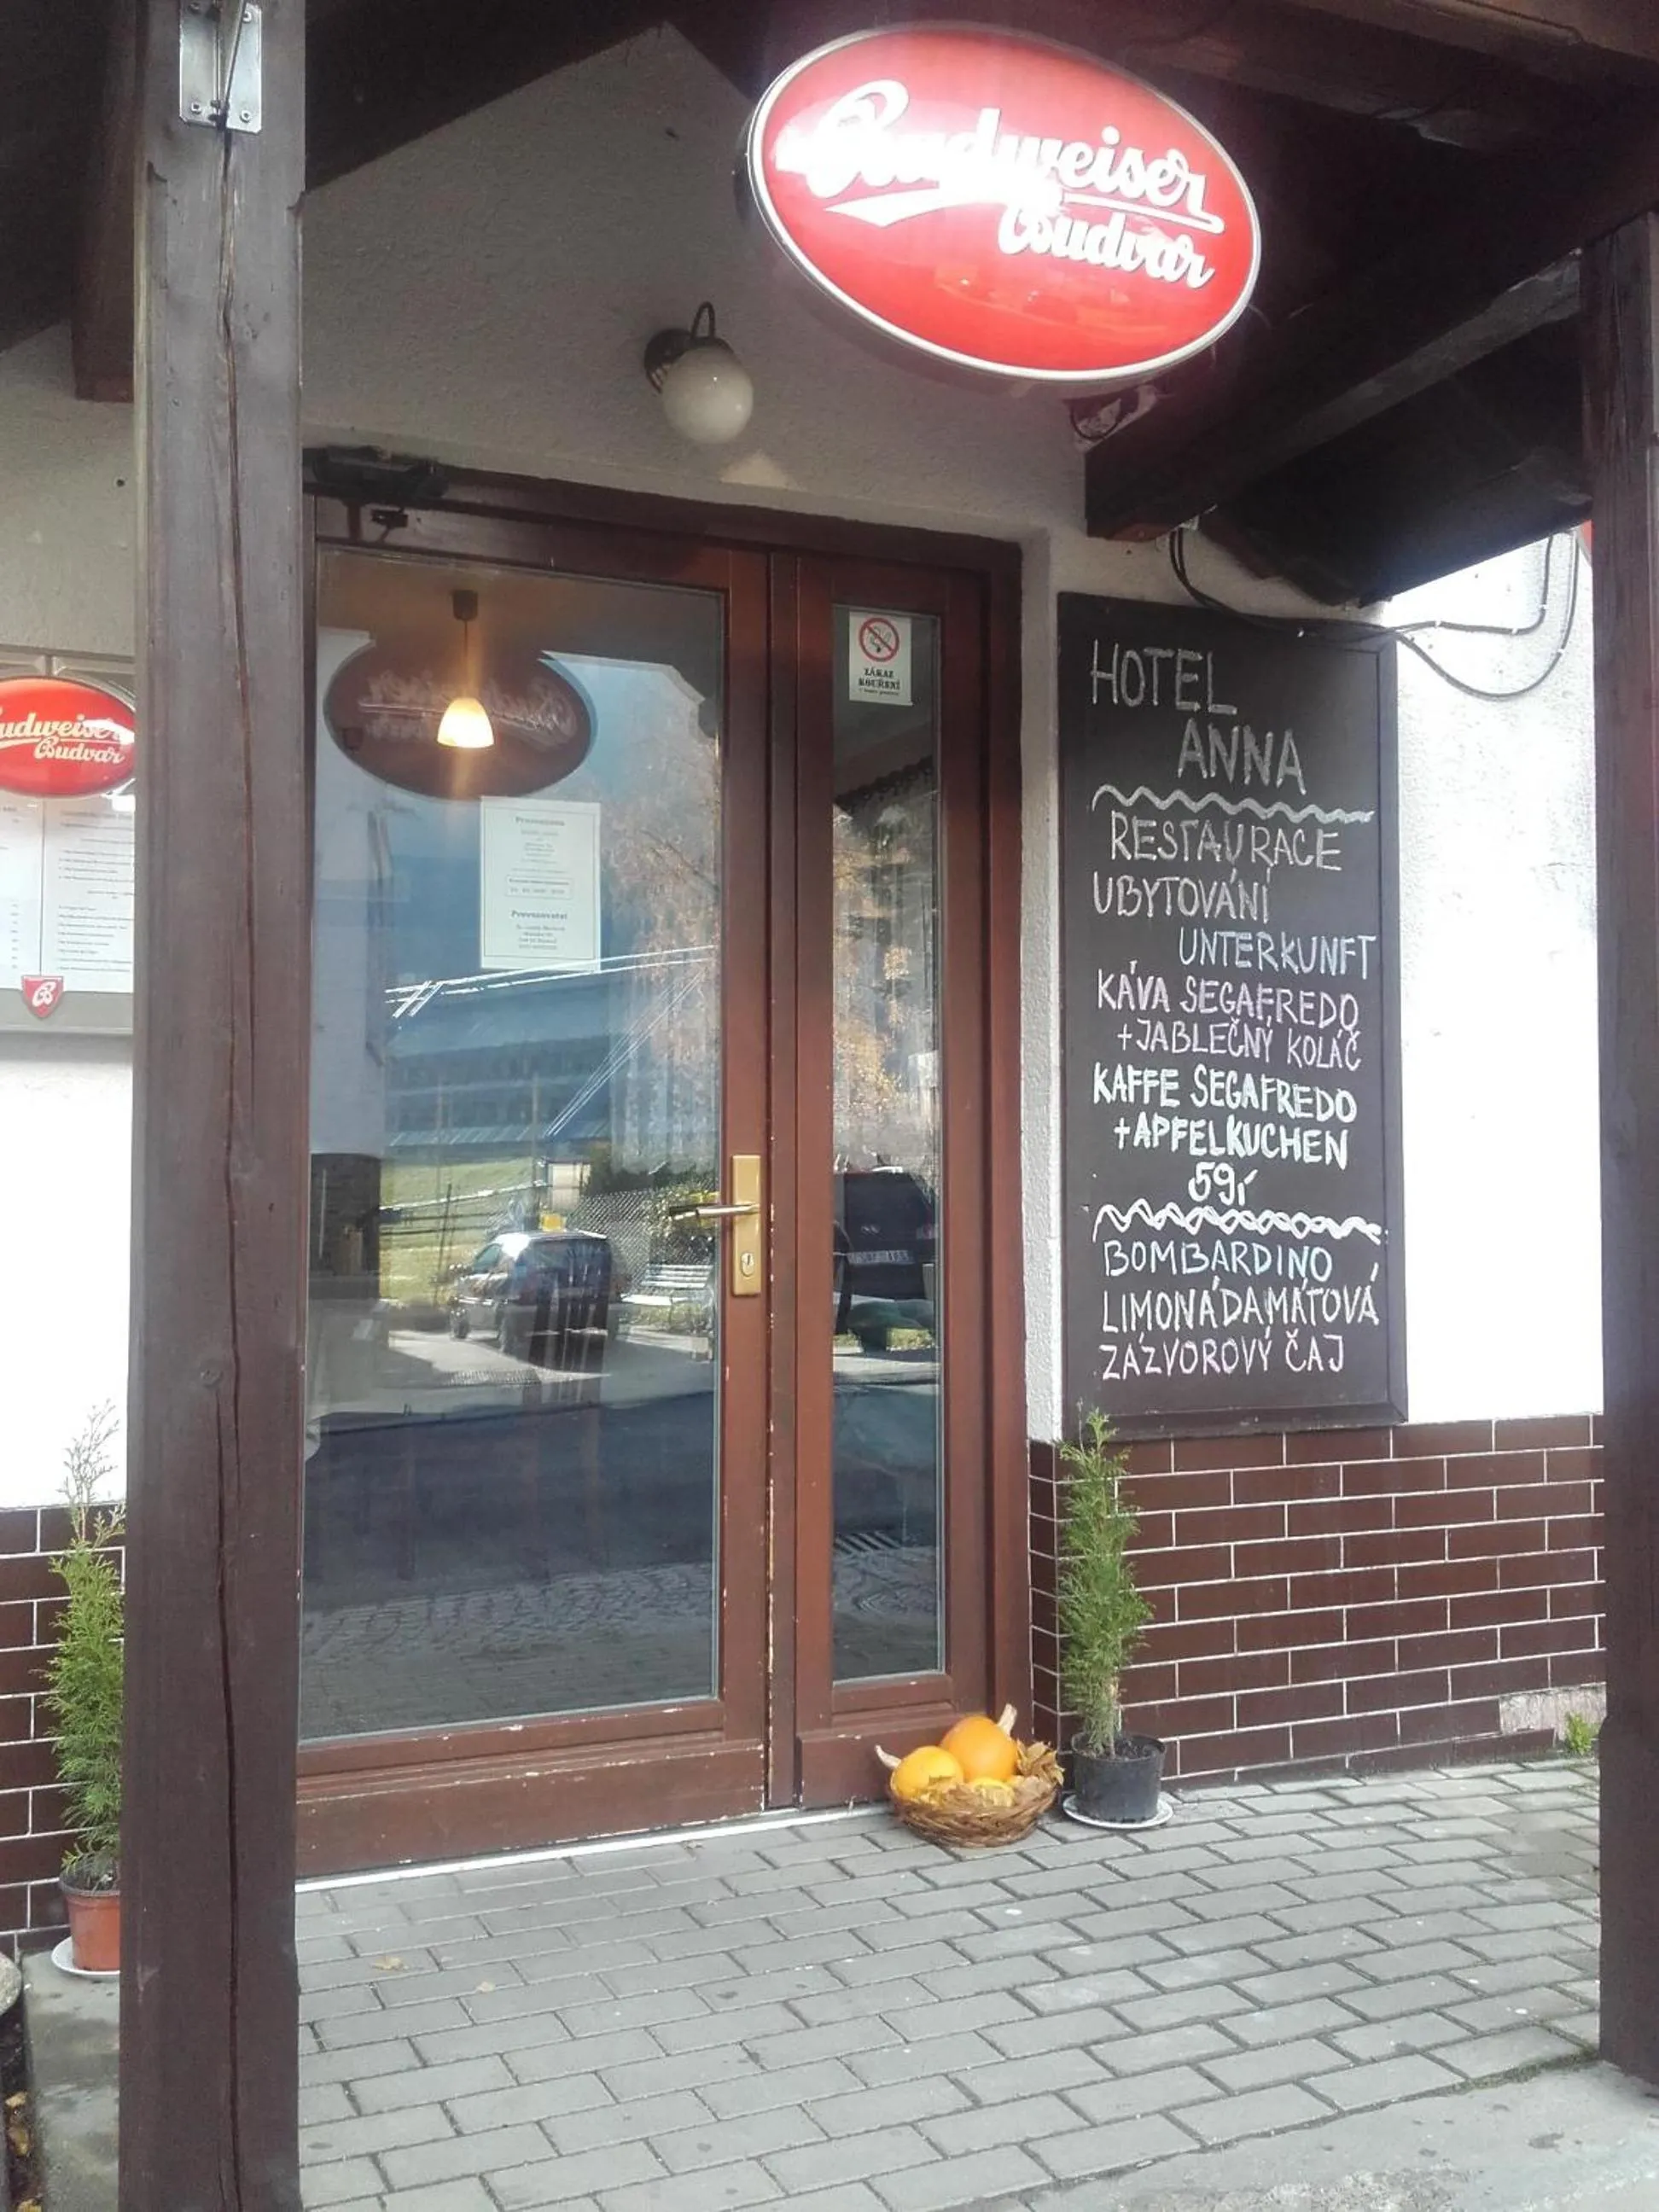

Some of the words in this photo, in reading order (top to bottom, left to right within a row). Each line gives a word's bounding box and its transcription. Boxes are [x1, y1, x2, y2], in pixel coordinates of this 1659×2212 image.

[775, 79, 1225, 232] Budweiser
[998, 195, 1215, 288] Budvar
[1091, 639, 1237, 715] HOTEL
[33, 735, 125, 764] Budvar
[1177, 717, 1307, 795] ANNA
[1110, 809, 1342, 871] RESTAURACE
[1091, 867, 1272, 924] UBYTOVÁNÍ
[1179, 927, 1377, 980] UNTERKUNFT
[1097, 959, 1171, 1013] KÁVA
[1179, 974, 1360, 1031] SEGAFREDO
[1286, 1027, 1362, 1072] KOLÁČ
[1092, 1061, 1181, 1109] KAFFE
[1189, 1062, 1358, 1123] SEGAFREDO
[1103, 1239, 1333, 1282] BOMBARDINO
[1098, 1325, 1273, 1381] ZÁZVOROVÝ
[1284, 1329, 1346, 1374] ČAJ
